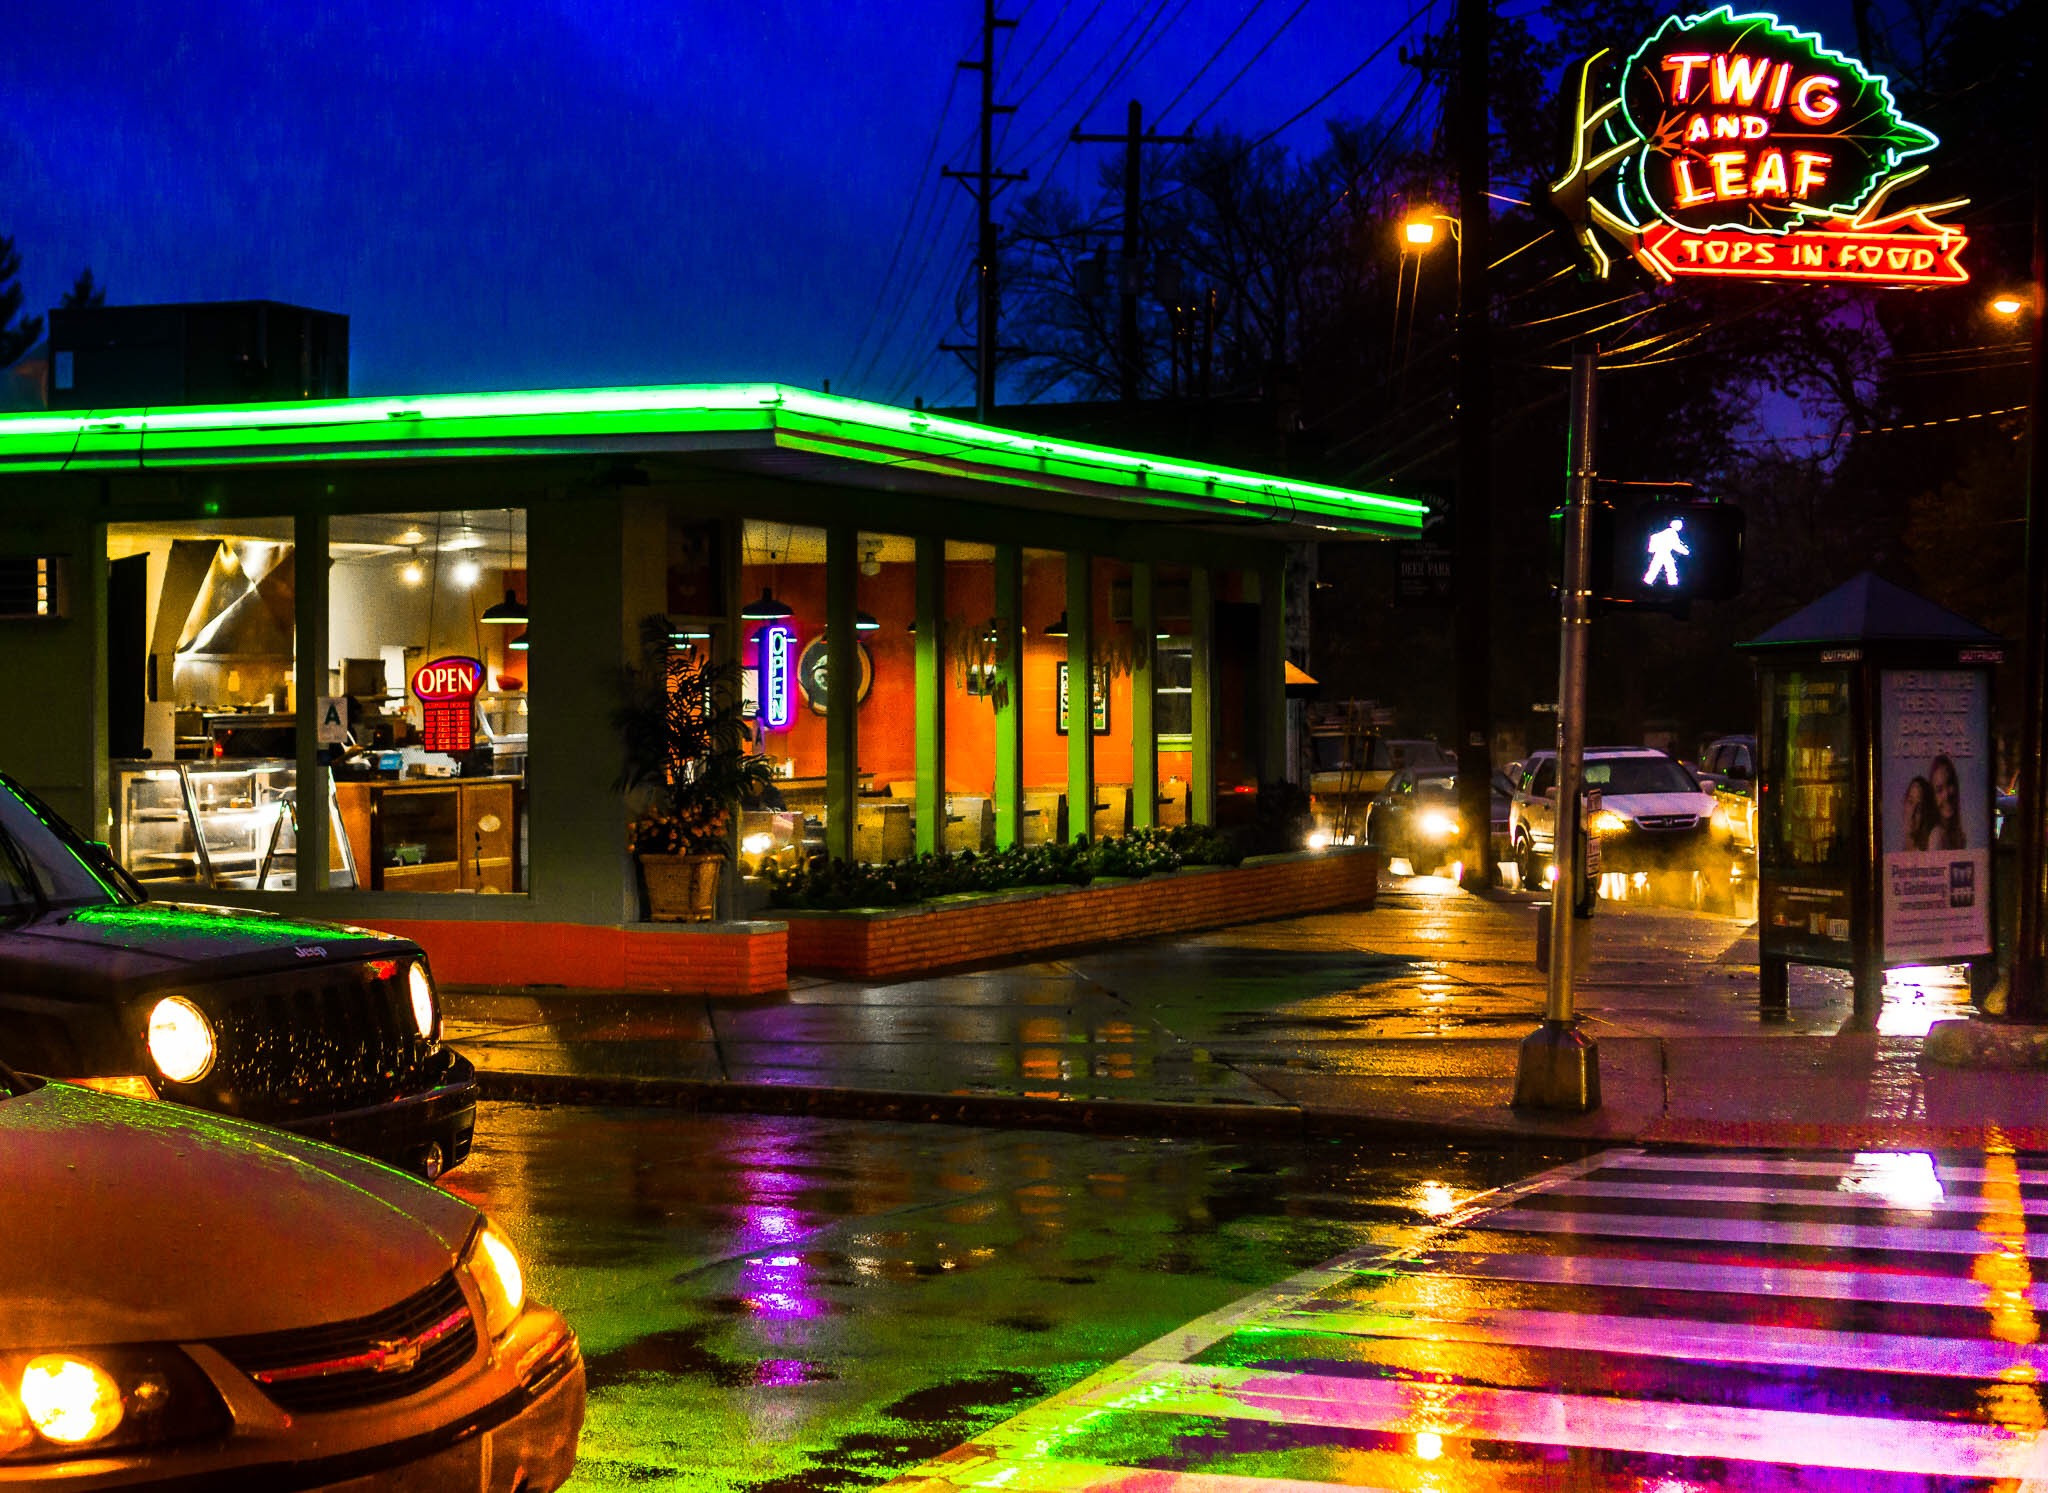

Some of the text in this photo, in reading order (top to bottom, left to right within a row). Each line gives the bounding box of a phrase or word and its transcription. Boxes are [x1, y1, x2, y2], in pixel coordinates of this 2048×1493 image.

[1661, 53, 1841, 123] TWIG
[1686, 114, 1770, 143] AND
[1674, 147, 1832, 208] LEAF
[1681, 240, 1935, 271] TOPS IN FOOD
[417, 666, 473, 693] OPEN
[771, 632, 784, 721] OPEN
[324, 703, 341, 726] A
[295, 946, 328, 958] Jeep
